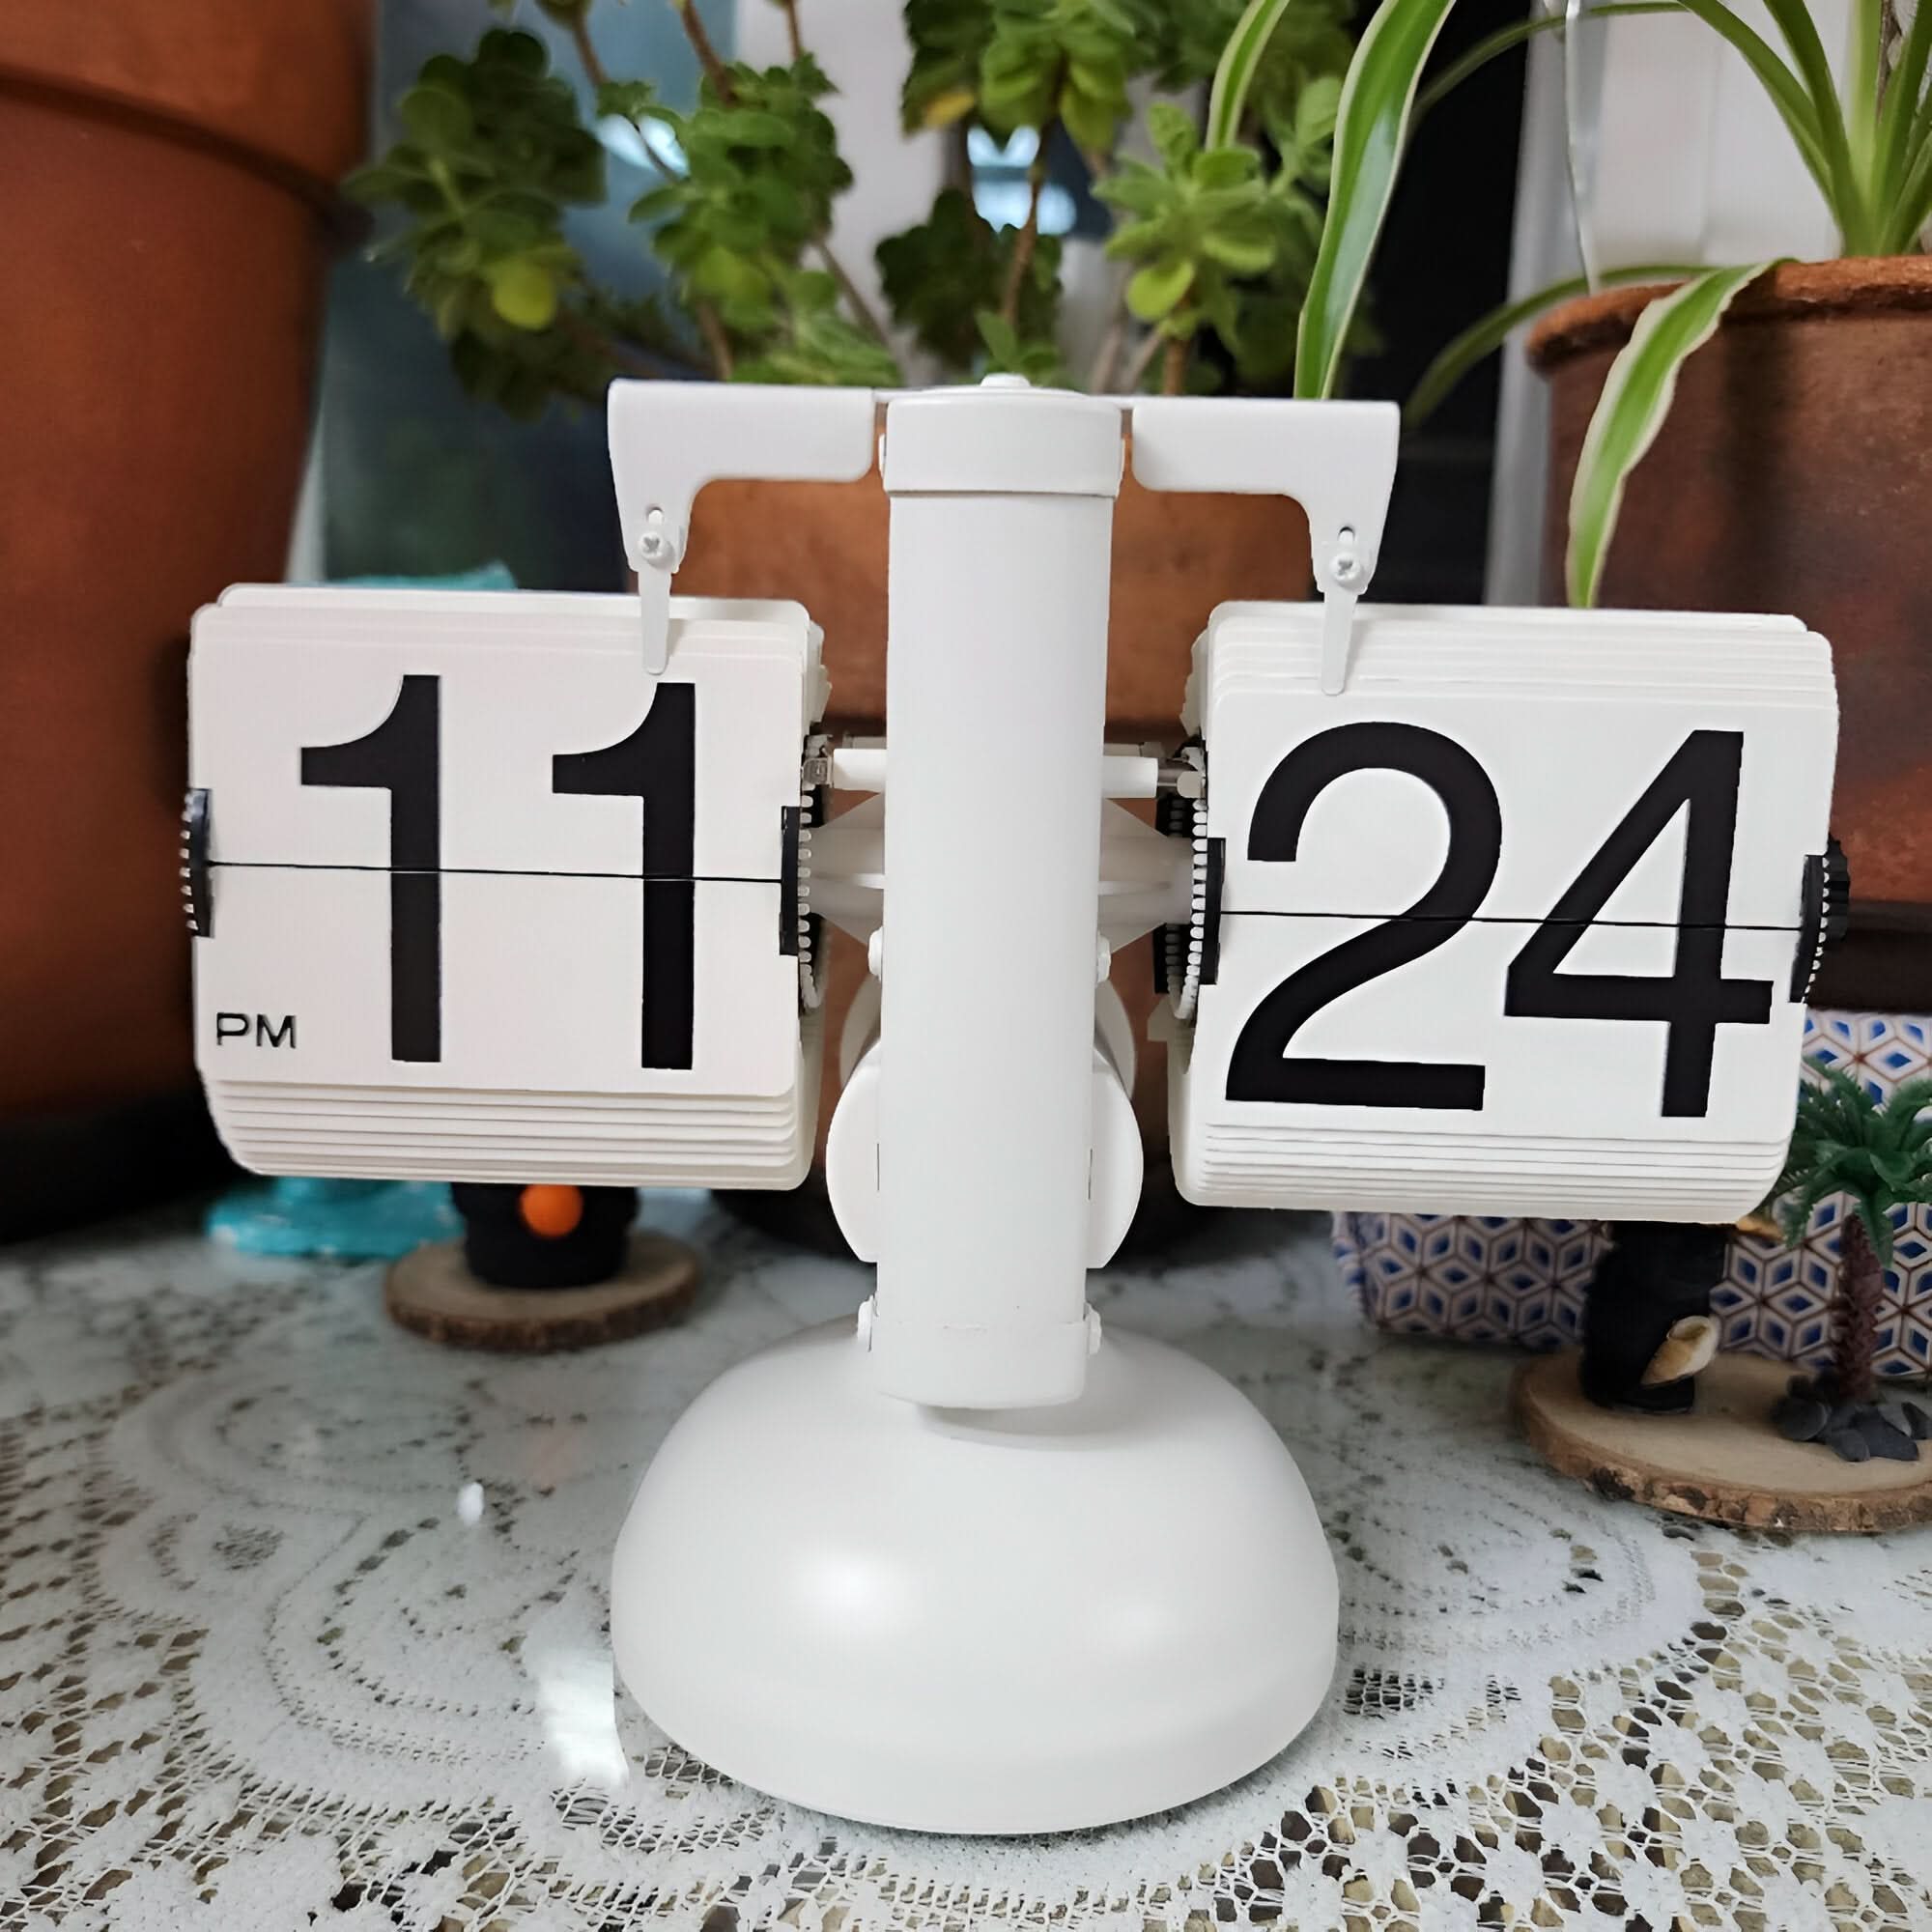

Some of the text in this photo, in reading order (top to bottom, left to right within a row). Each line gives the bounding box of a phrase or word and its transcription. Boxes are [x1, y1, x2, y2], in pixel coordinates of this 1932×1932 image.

[216, 1011, 297, 1049] PM
[300, 674, 696, 1069] 11
[1225, 722, 1774, 1118] 24
